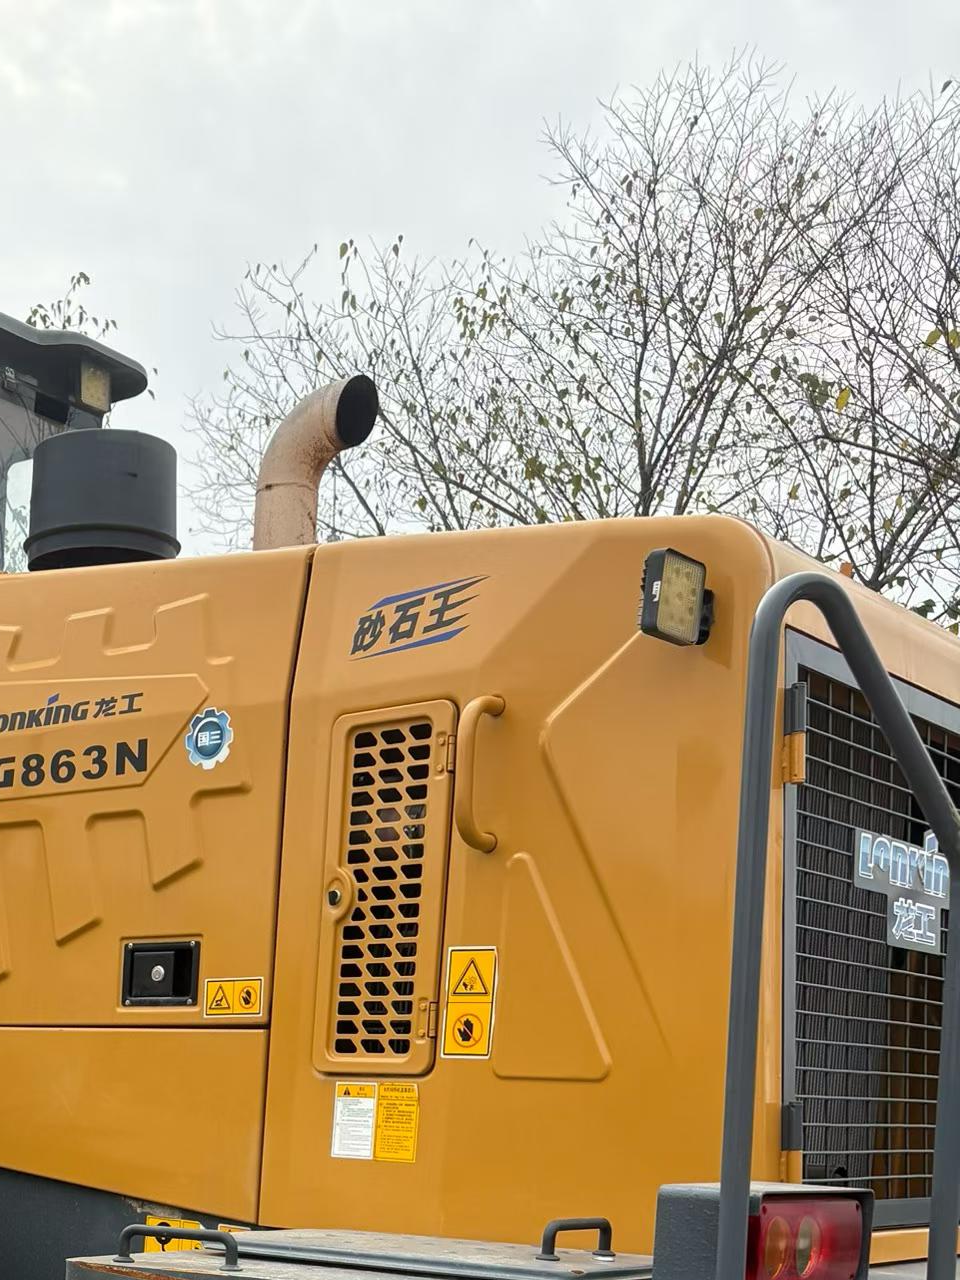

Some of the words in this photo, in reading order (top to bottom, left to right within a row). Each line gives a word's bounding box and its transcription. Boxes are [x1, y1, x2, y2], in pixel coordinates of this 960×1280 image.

[350, 576, 490, 656] 砂石王
[93, 692, 144, 719] 龙工
[892, 897, 936, 946] 龙工
